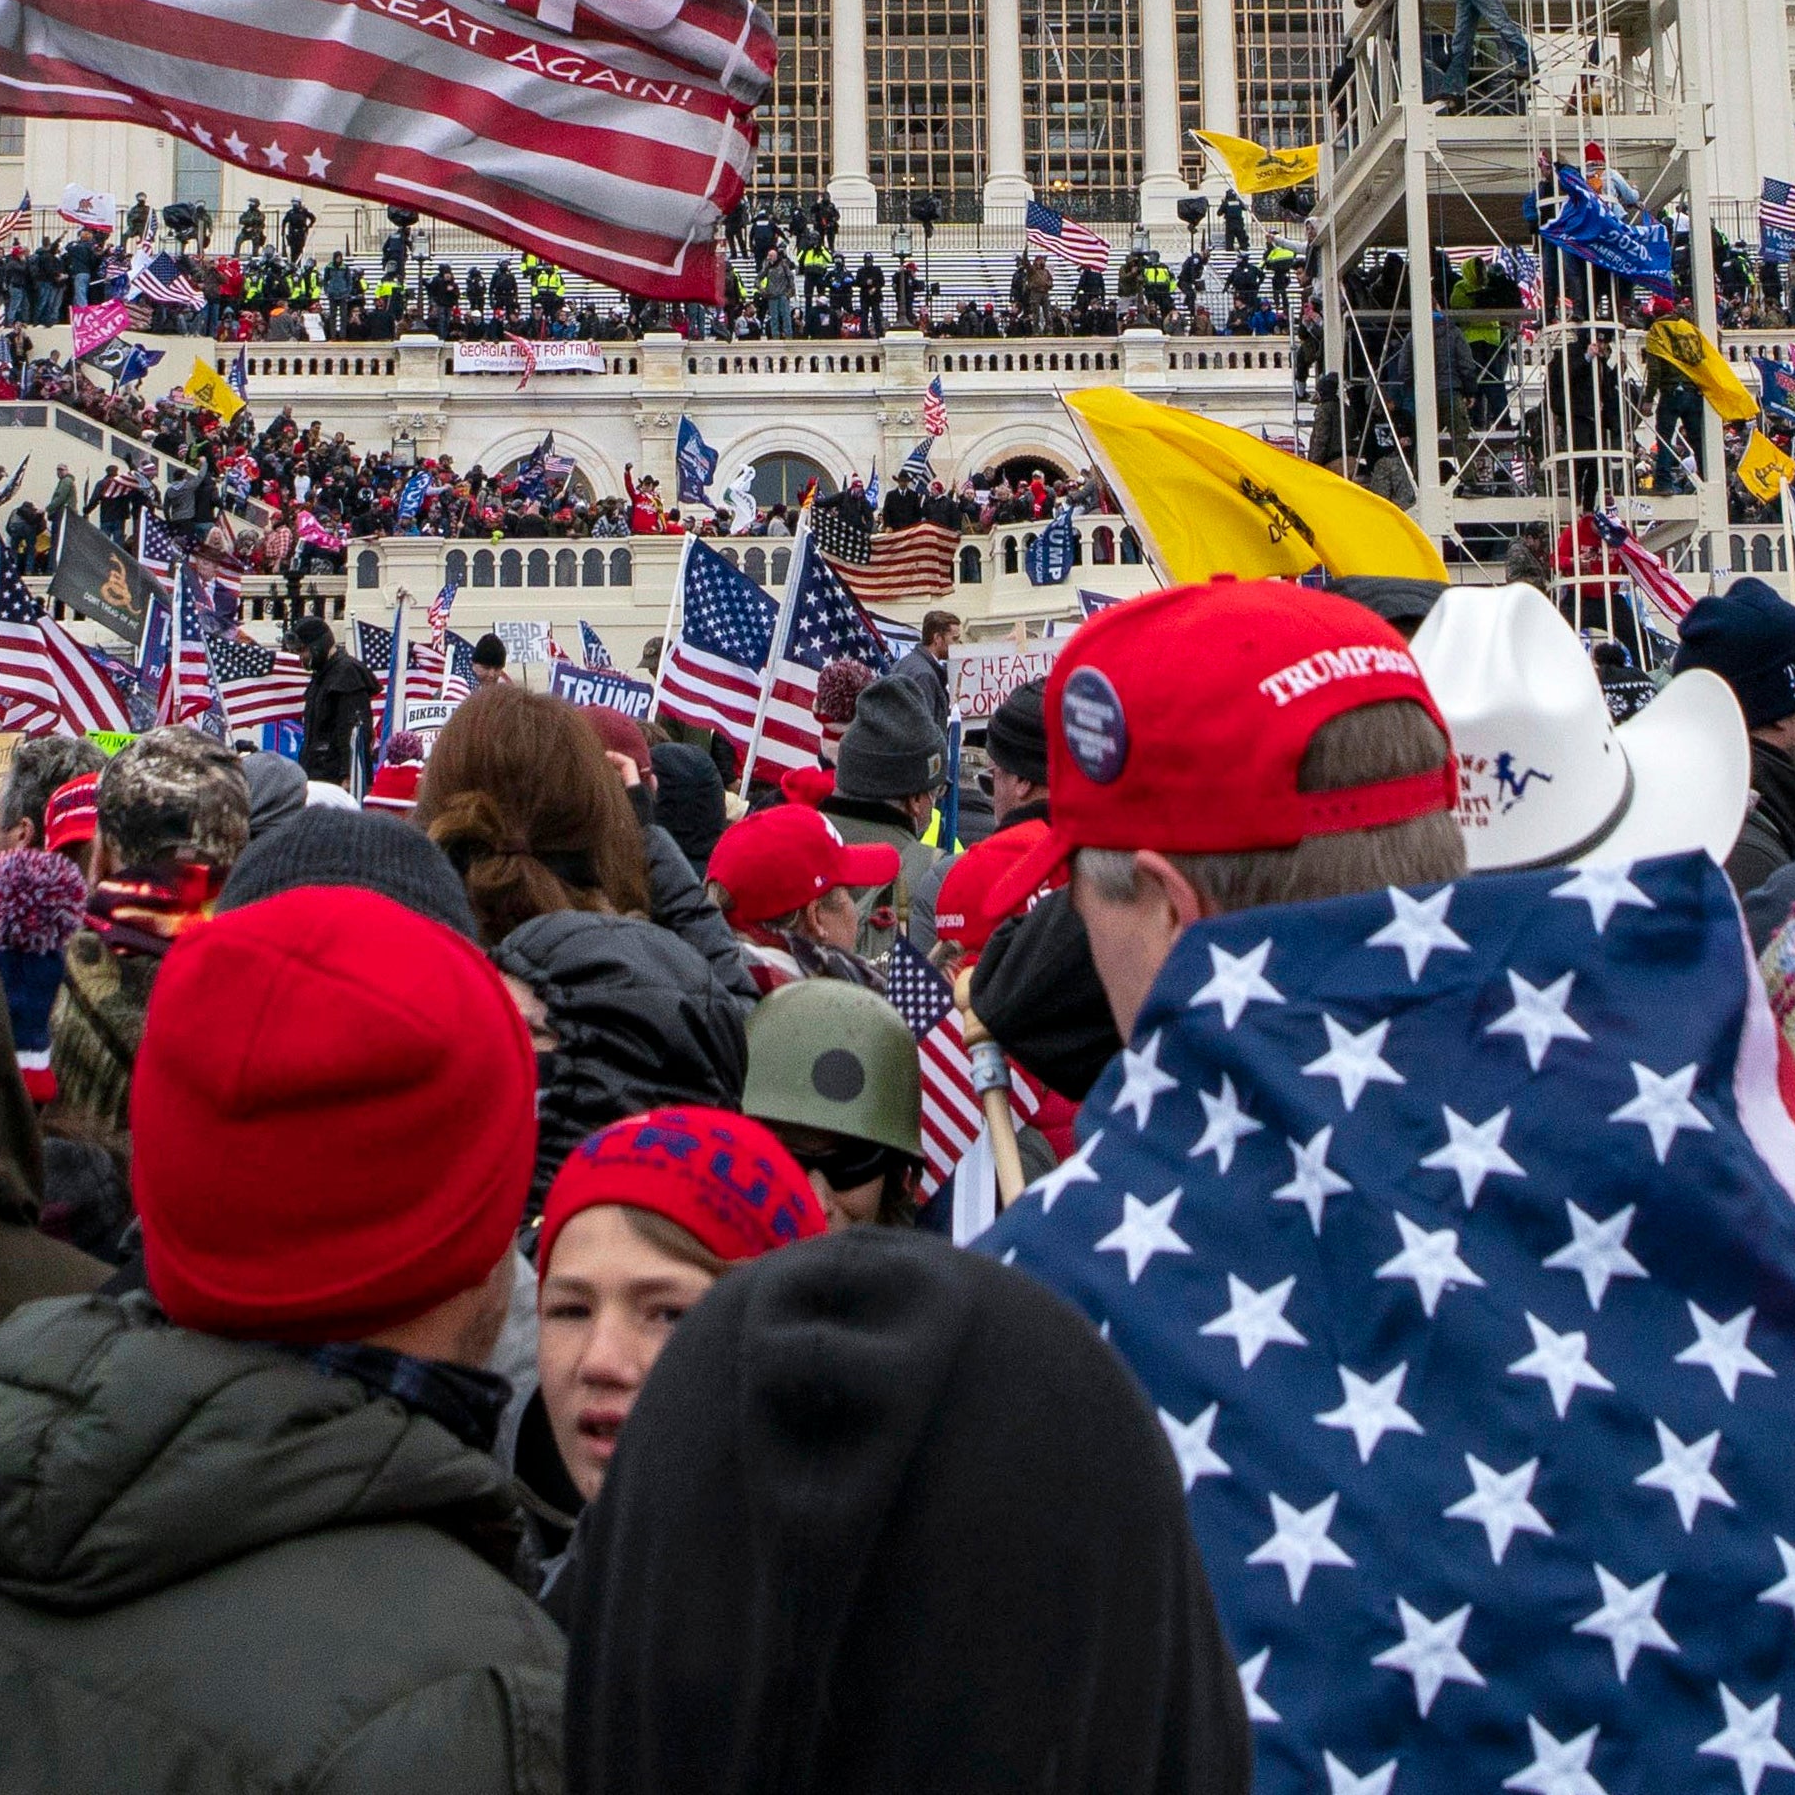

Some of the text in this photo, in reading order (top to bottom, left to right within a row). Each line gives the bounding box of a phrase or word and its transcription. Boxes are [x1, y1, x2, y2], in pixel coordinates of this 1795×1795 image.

[504, 41, 694, 108] AGAIN!
[1766, 226, 1793, 242] TRU
[460, 344, 507, 358] GEORGIA
[545, 344, 566, 357] FOR
[498, 622, 541, 638] SEND
[511, 651, 545, 664] JAIL
[559, 673, 652, 718] TRUMP
[408, 705, 447, 723] BIKERS
